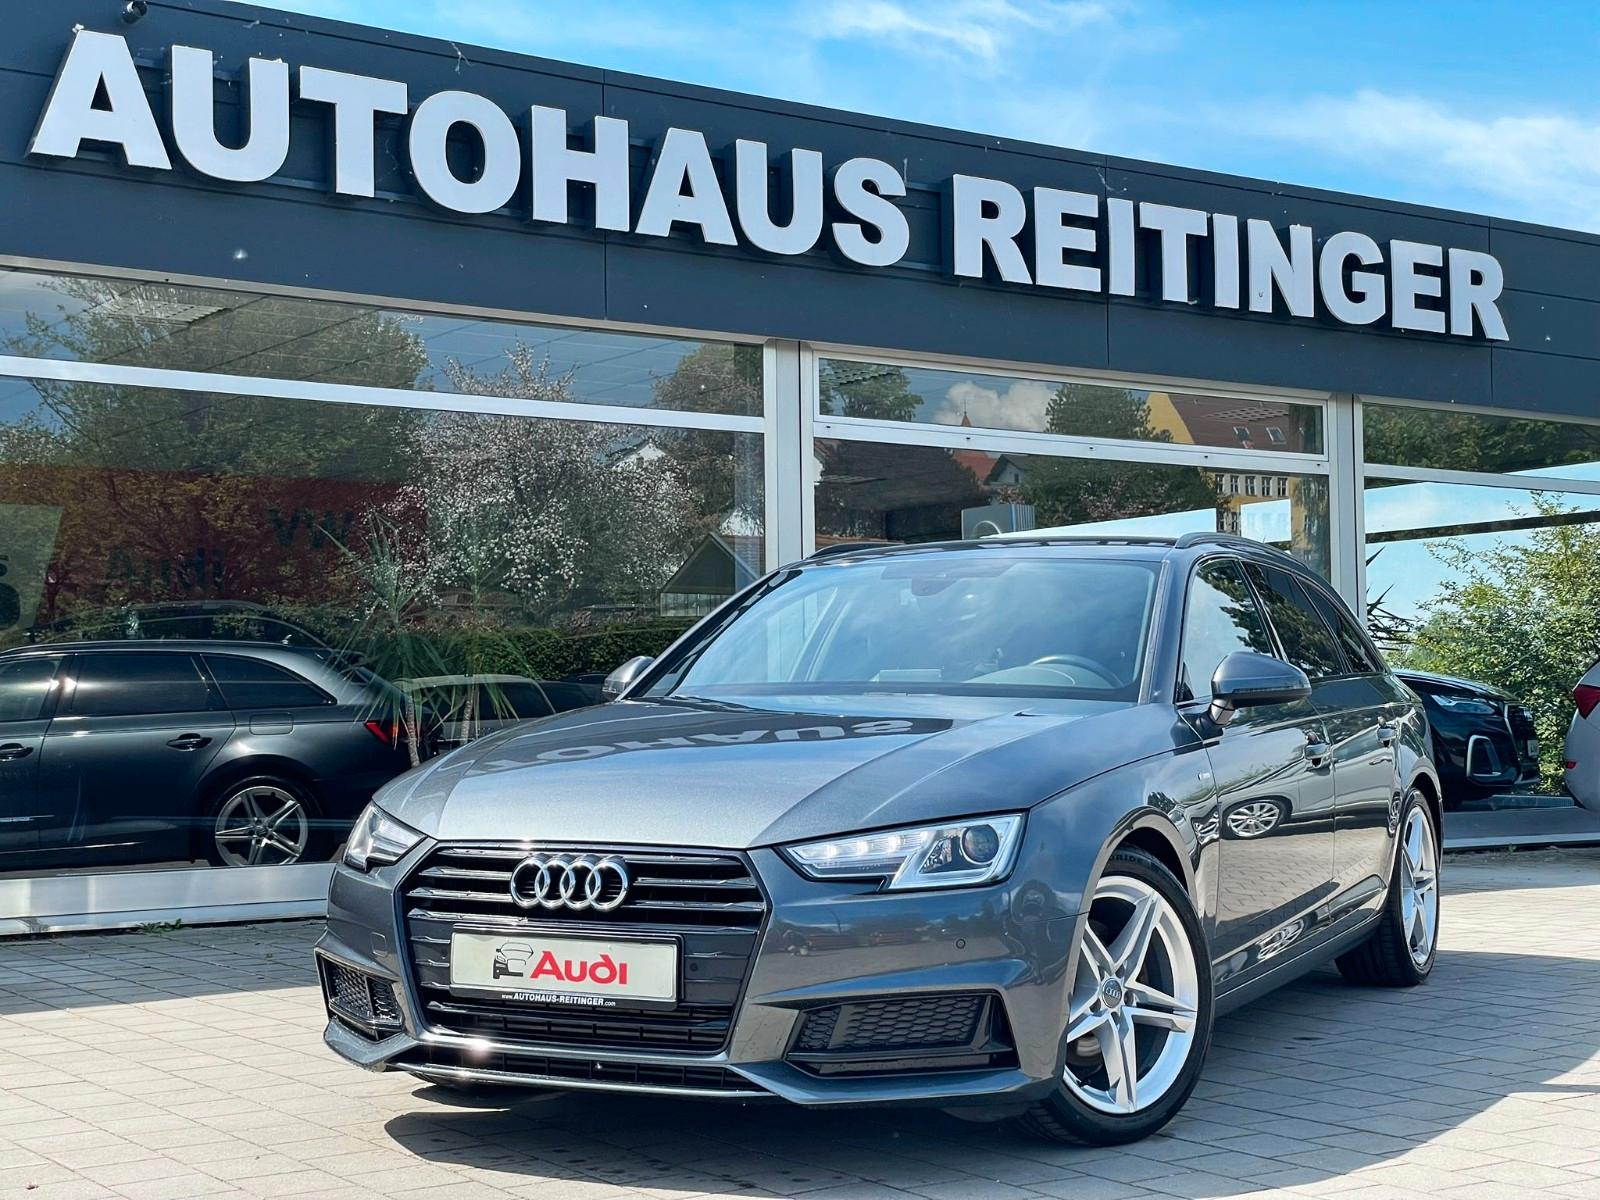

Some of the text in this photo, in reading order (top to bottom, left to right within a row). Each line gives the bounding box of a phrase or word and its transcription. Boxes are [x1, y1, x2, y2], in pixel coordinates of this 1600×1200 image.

[28, 29, 1510, 341] AUTOHAUS REITINGER
[530, 950, 628, 985] Audi
[501, 992, 616, 1006] www.AUTOHAUS-REITINGER.com
